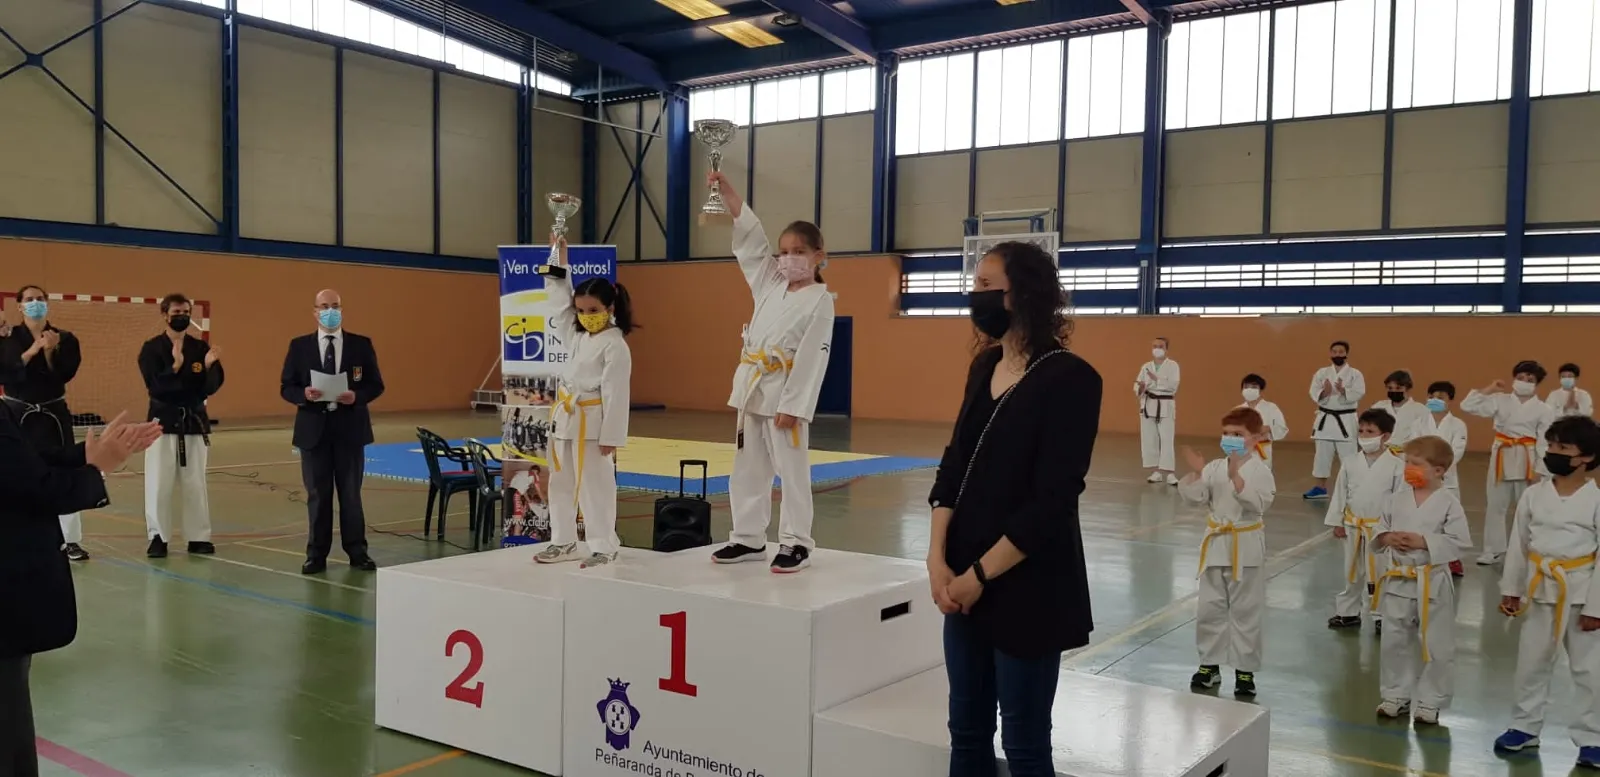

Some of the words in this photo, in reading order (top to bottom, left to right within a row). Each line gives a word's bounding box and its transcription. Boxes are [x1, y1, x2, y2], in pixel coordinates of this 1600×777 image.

[503, 259, 529, 279] ¡Ven
[569, 259, 611, 276] osotros!
[445, 629, 484, 708] 2
[658, 611, 697, 698] 1
[595, 748, 661, 777] Peñaranda
[643, 740, 742, 777] Ayuntamiento
